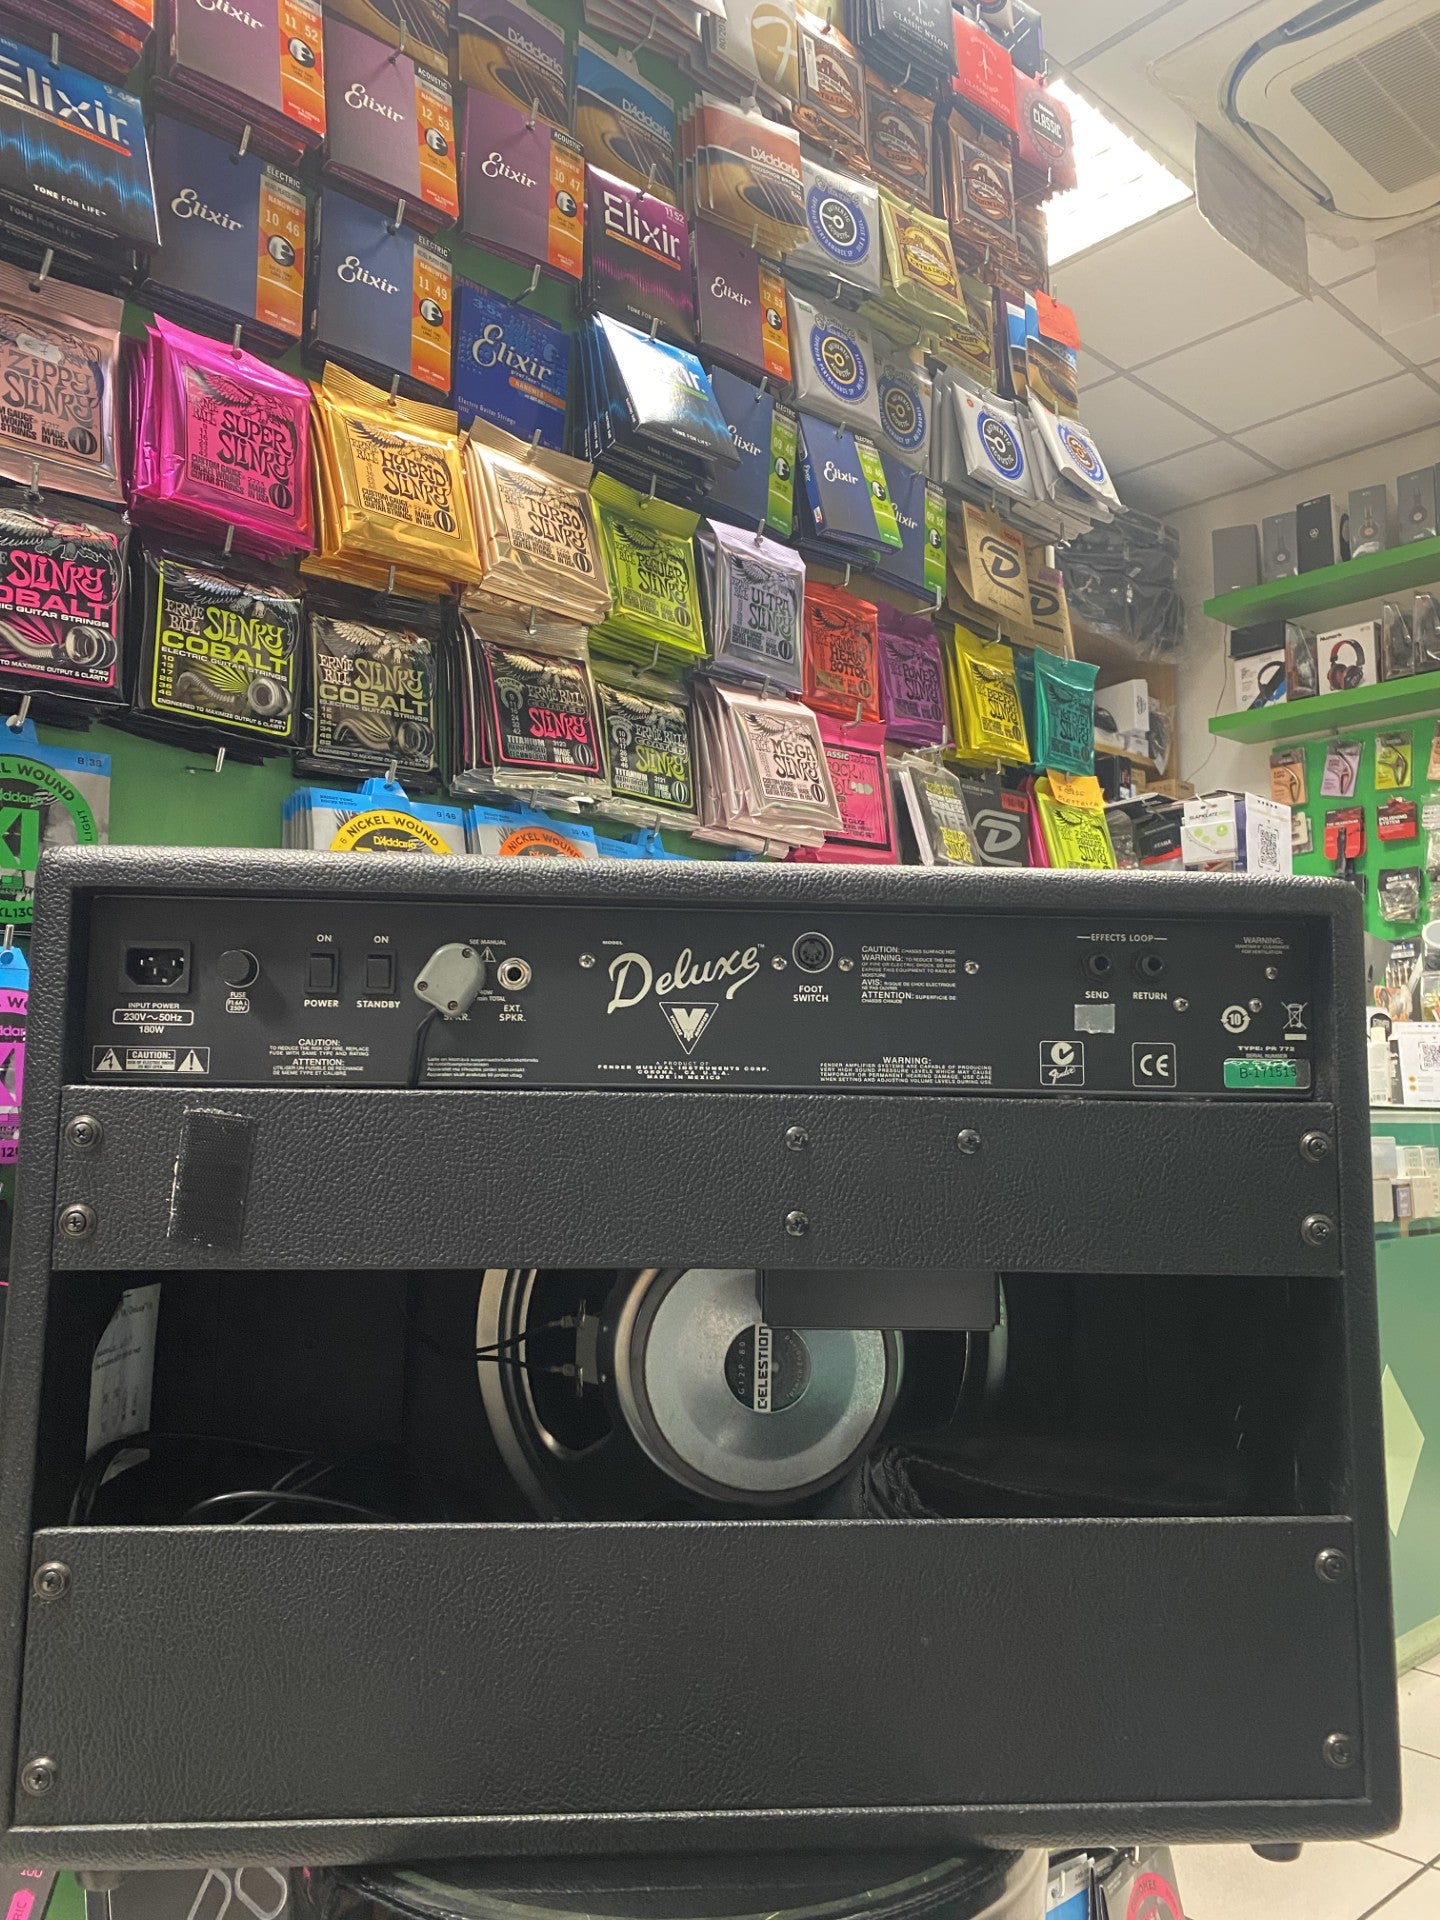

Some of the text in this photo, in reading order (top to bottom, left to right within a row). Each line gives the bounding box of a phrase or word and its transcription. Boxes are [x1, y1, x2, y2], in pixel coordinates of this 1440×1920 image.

[893, 11, 923, 34] CLASSIC
[925, 30, 948, 50] NYLON
[344, 83, 404, 123] Elixir
[1033, 108, 1062, 139] CLASSIC
[482, 152, 536, 189] Elixir
[751, 146, 800, 178] D'Addario
[266, 165, 301, 189] ELECTRIC
[33, 184, 58, 199] TONE
[61, 193, 80, 208] FOR
[171, 187, 243, 232] Elixir
[418, 236, 448, 258] ELECTRIC
[337, 256, 399, 295] Elixir
[711, 276, 752, 307] Elixir
[472, 323, 551, 380] Elixir
[1, 414, 33, 430] WOUND
[7, 408, 34, 422] GAUGE
[1, 423, 37, 440] STRINGS
[42, 427, 65, 440] MADE
[221, 410, 291, 457] SUPER
[52, 438, 69, 449] USA
[823, 461, 859, 485] Elixir
[525, 496, 581, 530] TURBO
[0, 585, 109, 620] OBALT
[752, 587, 790, 612] ULTRA
[16, 606, 109, 628] GUITAR STRINGS
[169, 613, 200, 636] BALL
[162, 630, 287, 674] COBALT
[12, 661, 109, 682] MAXIMIZE OUTPUT CLARITY
[162, 646, 288, 682] ELECTRIC GUITAR STRINGS
[324, 668, 351, 686] BALL
[320, 684, 428, 716] COBALT
[320, 699, 429, 723] ELECTRIC GUITAR STRINGS
[770, 738, 817, 762] MEGA
[826, 751, 850, 761] ASSIC
[18, 763, 75, 801] WOUND
[77, 810, 92, 841] LIGHT
[346, 815, 439, 846] NICKEL WOUND
[508, 832, 585, 858] NICKEL WOUND
[316, 934, 332, 942] ON
[374, 935, 389, 944] ON
[1091, 933, 1154, 942] EFFECTS LOOP
[862, 954, 904, 962] WARNING:
[793, 993, 829, 1002] SWITCH
[798, 985, 823, 993] FOOT
[861, 991, 915, 999] ATTENTION:
[1085, 990, 1109, 999] SEND
[1133, 992, 1167, 1000] RETURN
[304, 999, 339, 1008] POWER
[357, 1000, 401, 1008] STANDBY
[499, 1013, 527, 1022] SPKR.
[1229, 1013, 1242, 1026] 10
[139, 1026, 164, 1034] 180W
[132, 1051, 172, 1059] CAUTION:
[883, 1057, 932, 1065] WARNING:
[758, 1326, 768, 1409] CELESTION
